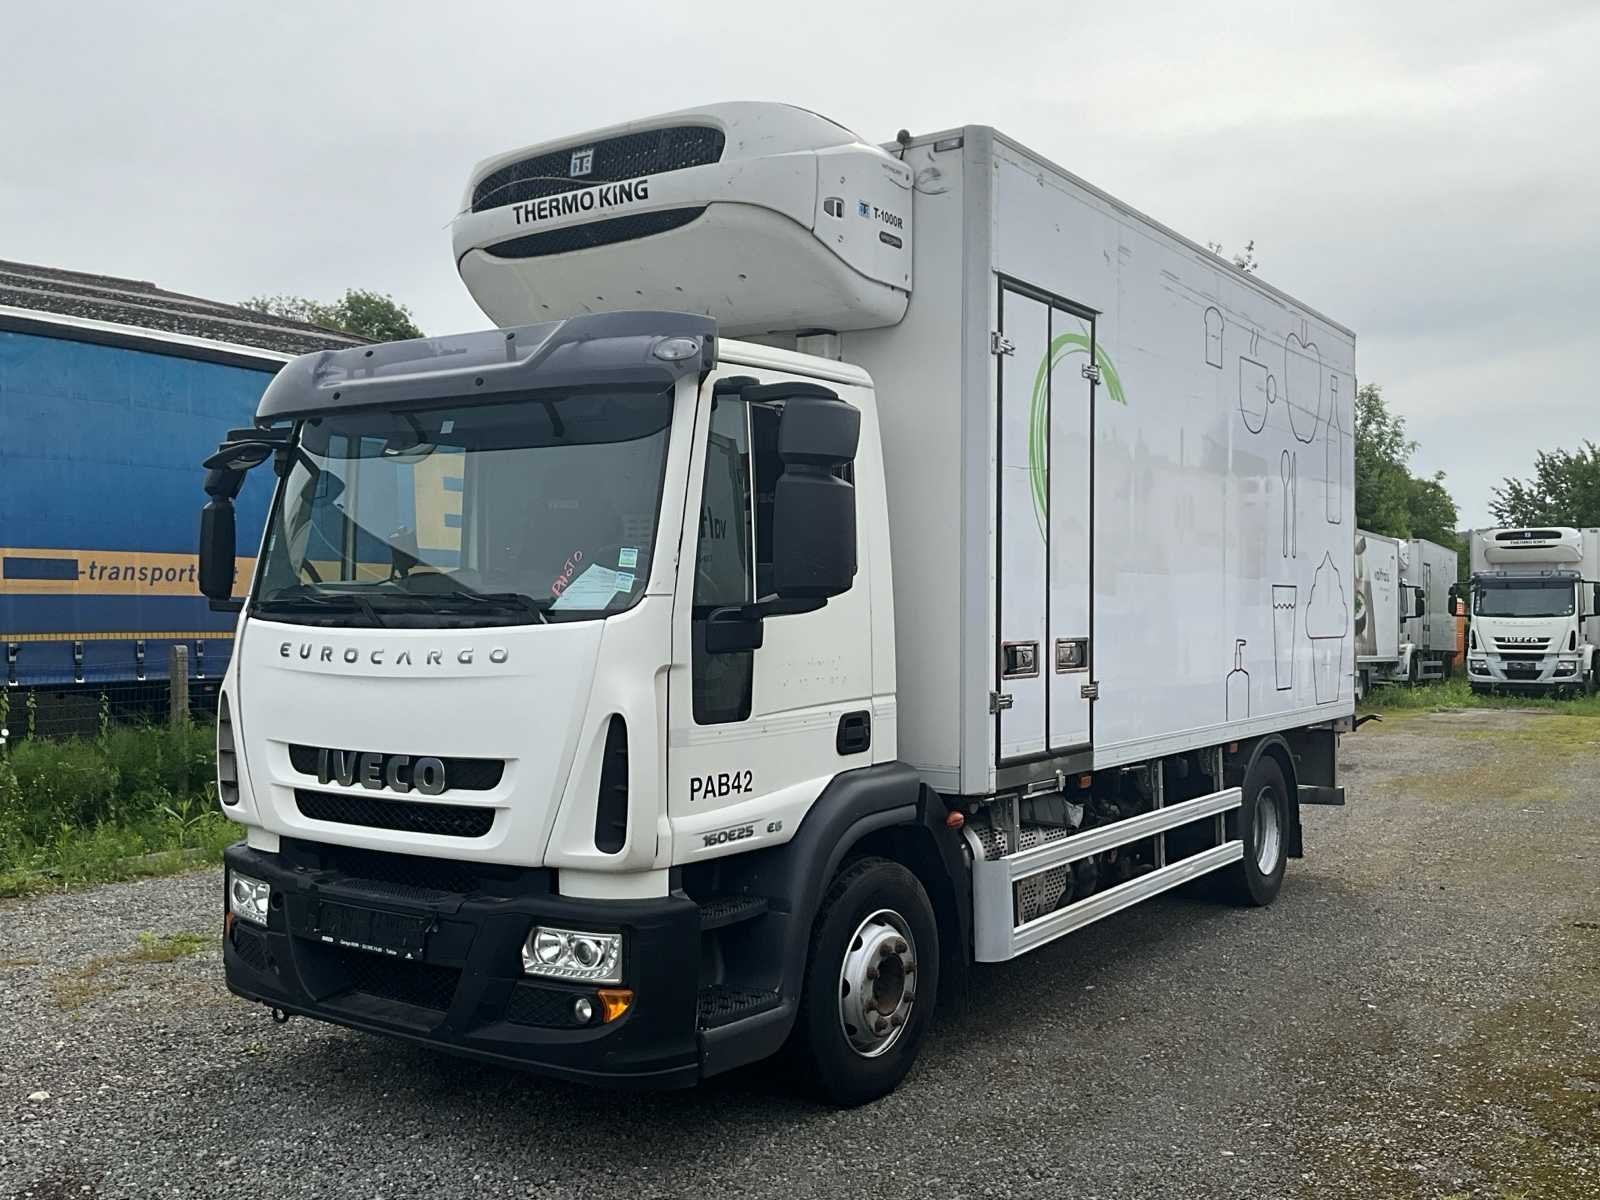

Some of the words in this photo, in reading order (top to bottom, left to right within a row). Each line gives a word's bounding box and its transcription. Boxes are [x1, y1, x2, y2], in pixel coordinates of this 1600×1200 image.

[513, 191, 594, 224] THERMO
[599, 179, 649, 208] KING
[873, 207, 903, 230] T-1000R
[279, 641, 509, 665] EUROCARGO
[316, 749, 446, 796] IVECO
[690, 770, 753, 801] PAB42
[702, 825, 754, 848] 160E25
